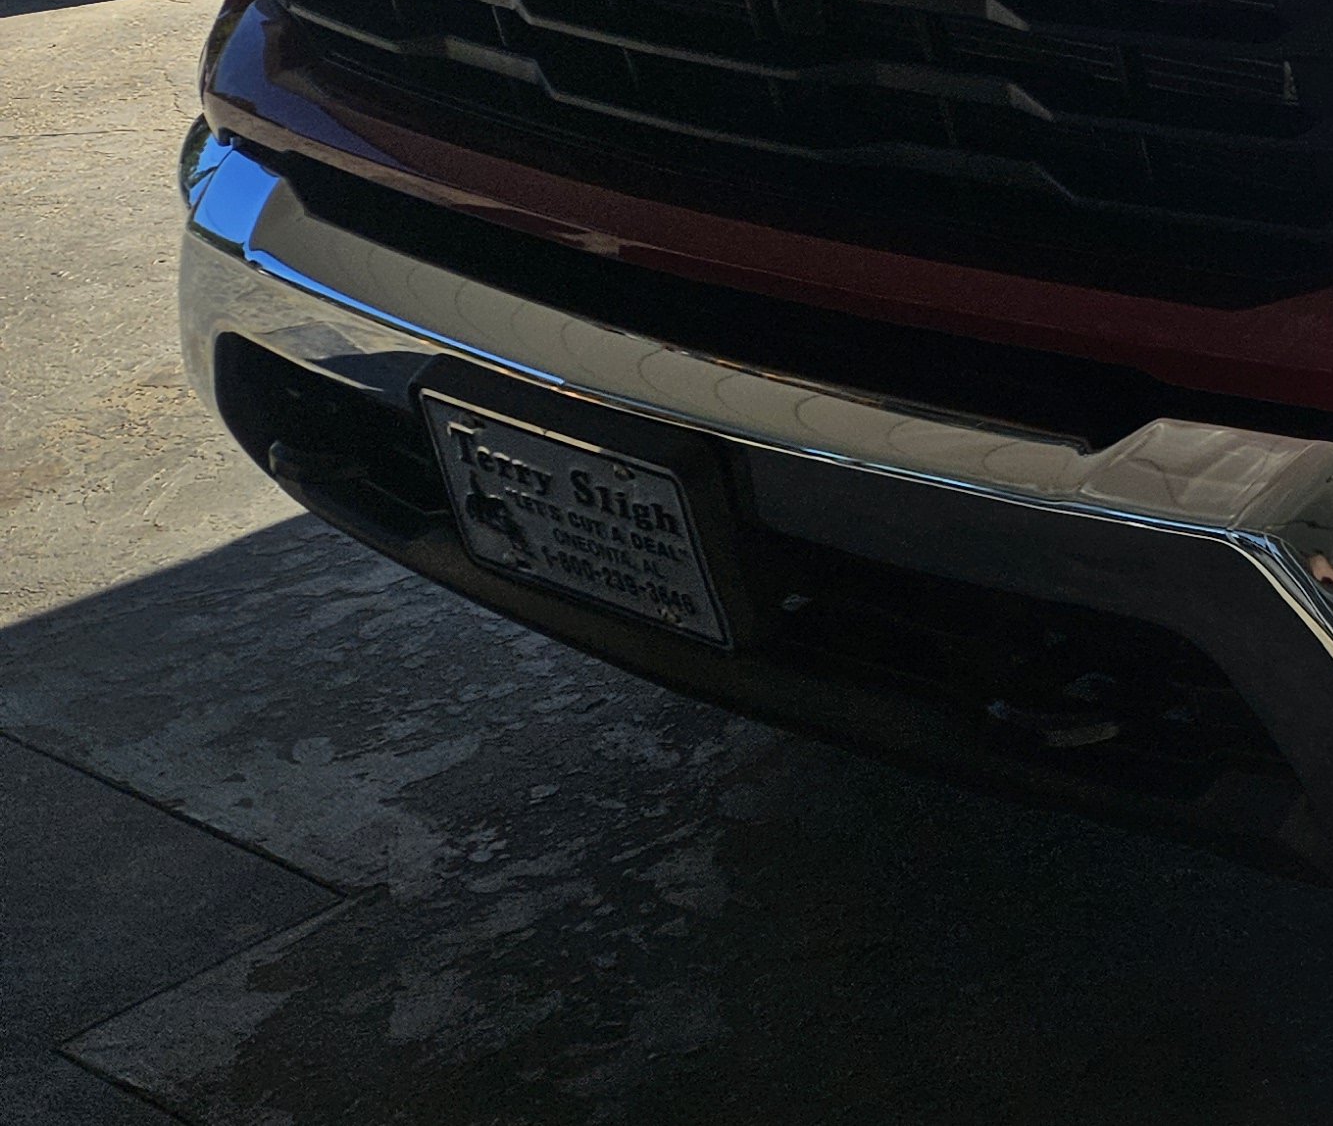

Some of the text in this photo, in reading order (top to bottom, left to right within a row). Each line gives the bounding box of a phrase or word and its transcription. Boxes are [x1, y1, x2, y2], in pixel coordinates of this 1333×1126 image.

[446, 420, 683, 538] Terry Sligh
[568, 511, 606, 538] CUT
[610, 524, 627, 545] A
